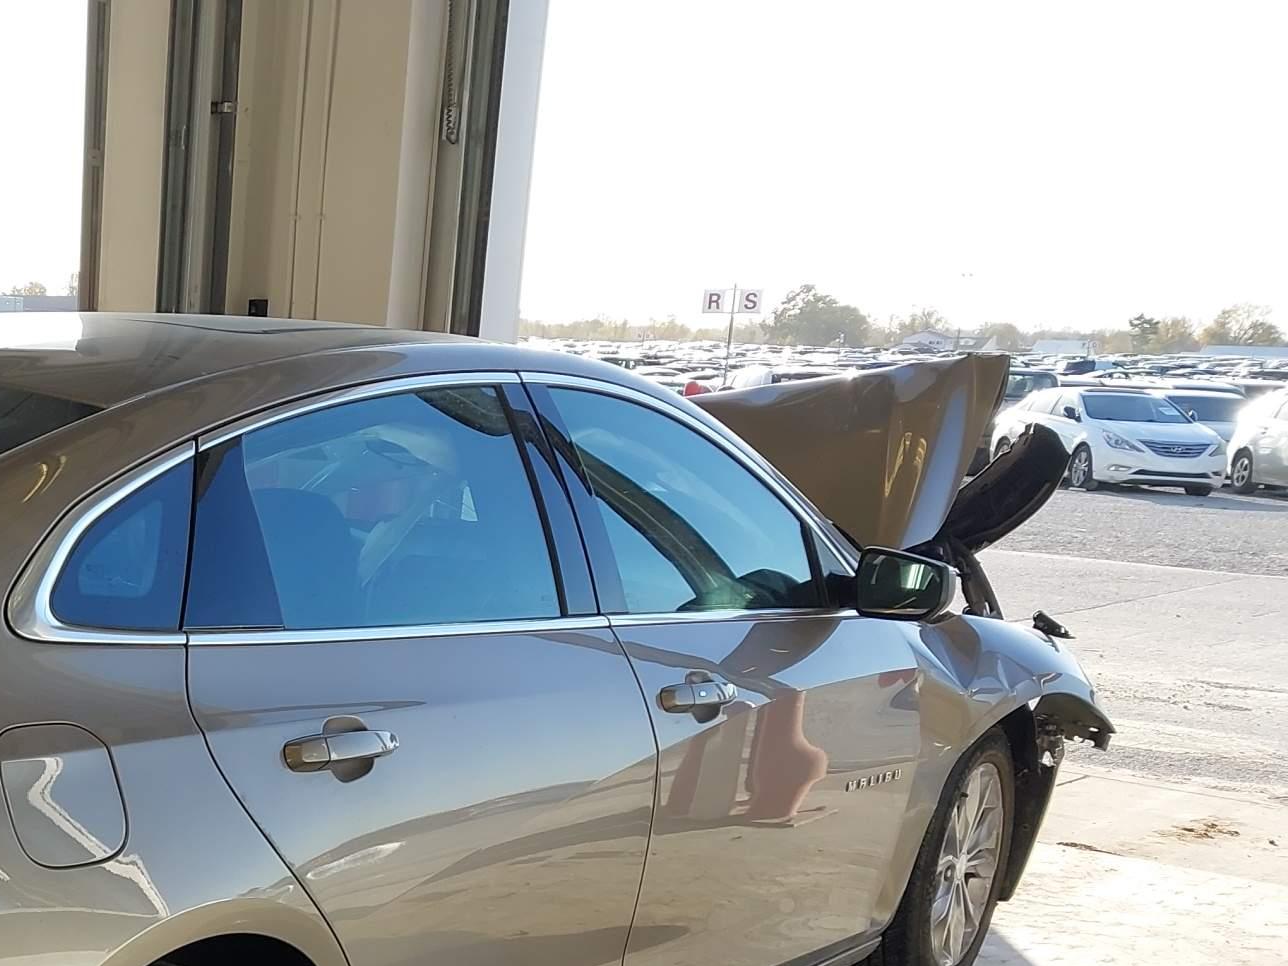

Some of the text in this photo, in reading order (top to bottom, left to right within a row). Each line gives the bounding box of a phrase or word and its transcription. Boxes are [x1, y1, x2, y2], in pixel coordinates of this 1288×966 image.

[707, 292, 758, 310] R S
[845, 768, 903, 793] MALIBU
